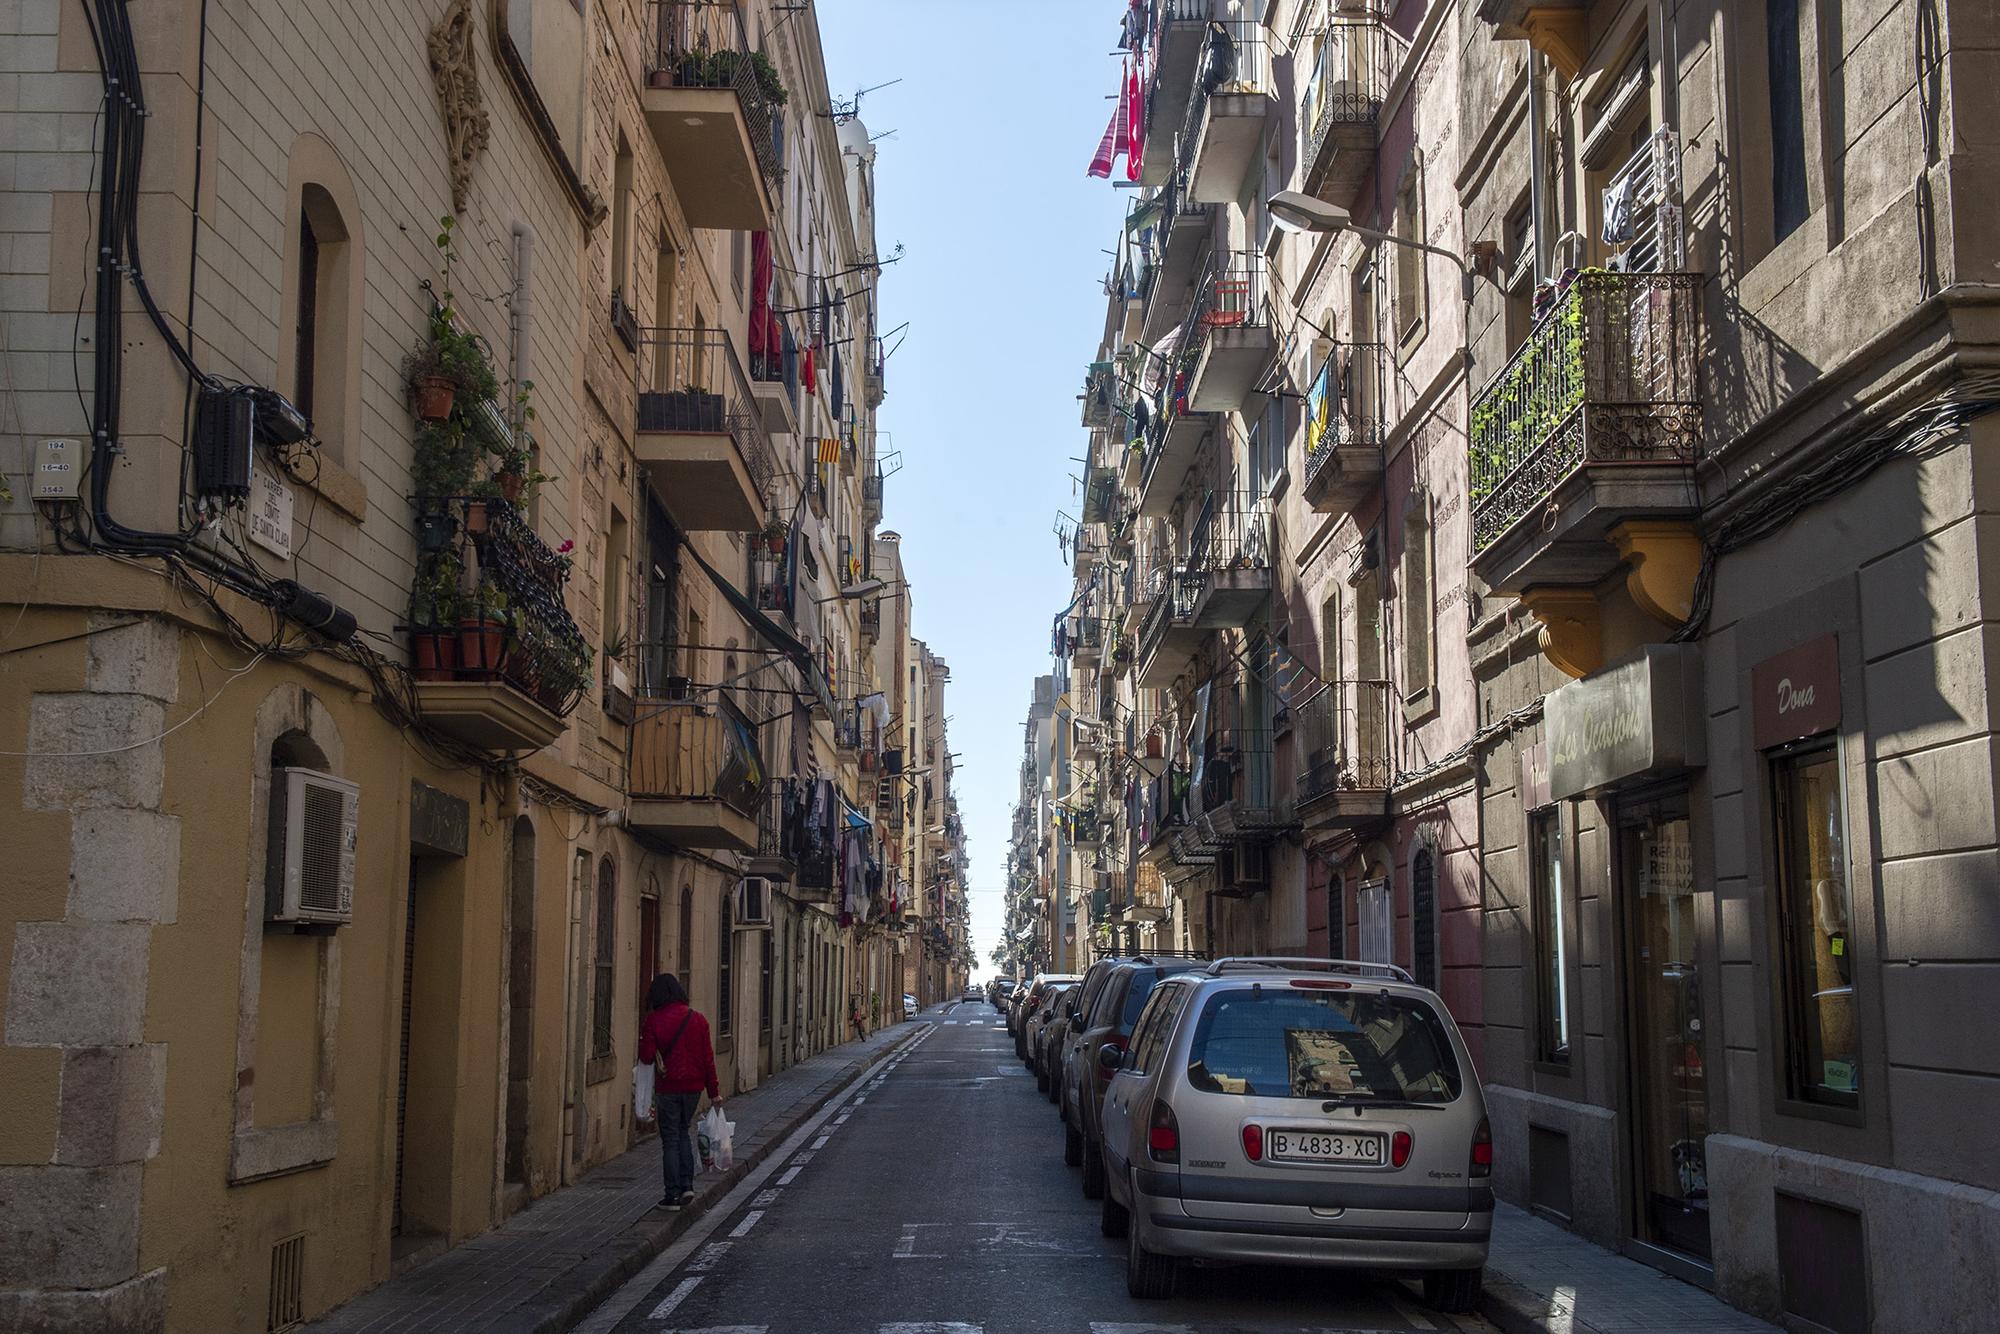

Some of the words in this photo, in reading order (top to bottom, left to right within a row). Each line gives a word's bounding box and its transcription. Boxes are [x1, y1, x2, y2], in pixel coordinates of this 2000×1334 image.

[263, 477, 283, 497] CARRER
[268, 492, 278, 506] DEL
[264, 501, 280, 525] COMTE
[252, 513, 259, 532] DE
[260, 518, 274, 540] SANTA
[275, 527, 290, 549] CLARA
[1777, 678, 1816, 715] Dona
[1554, 716, 1578, 766] Les
